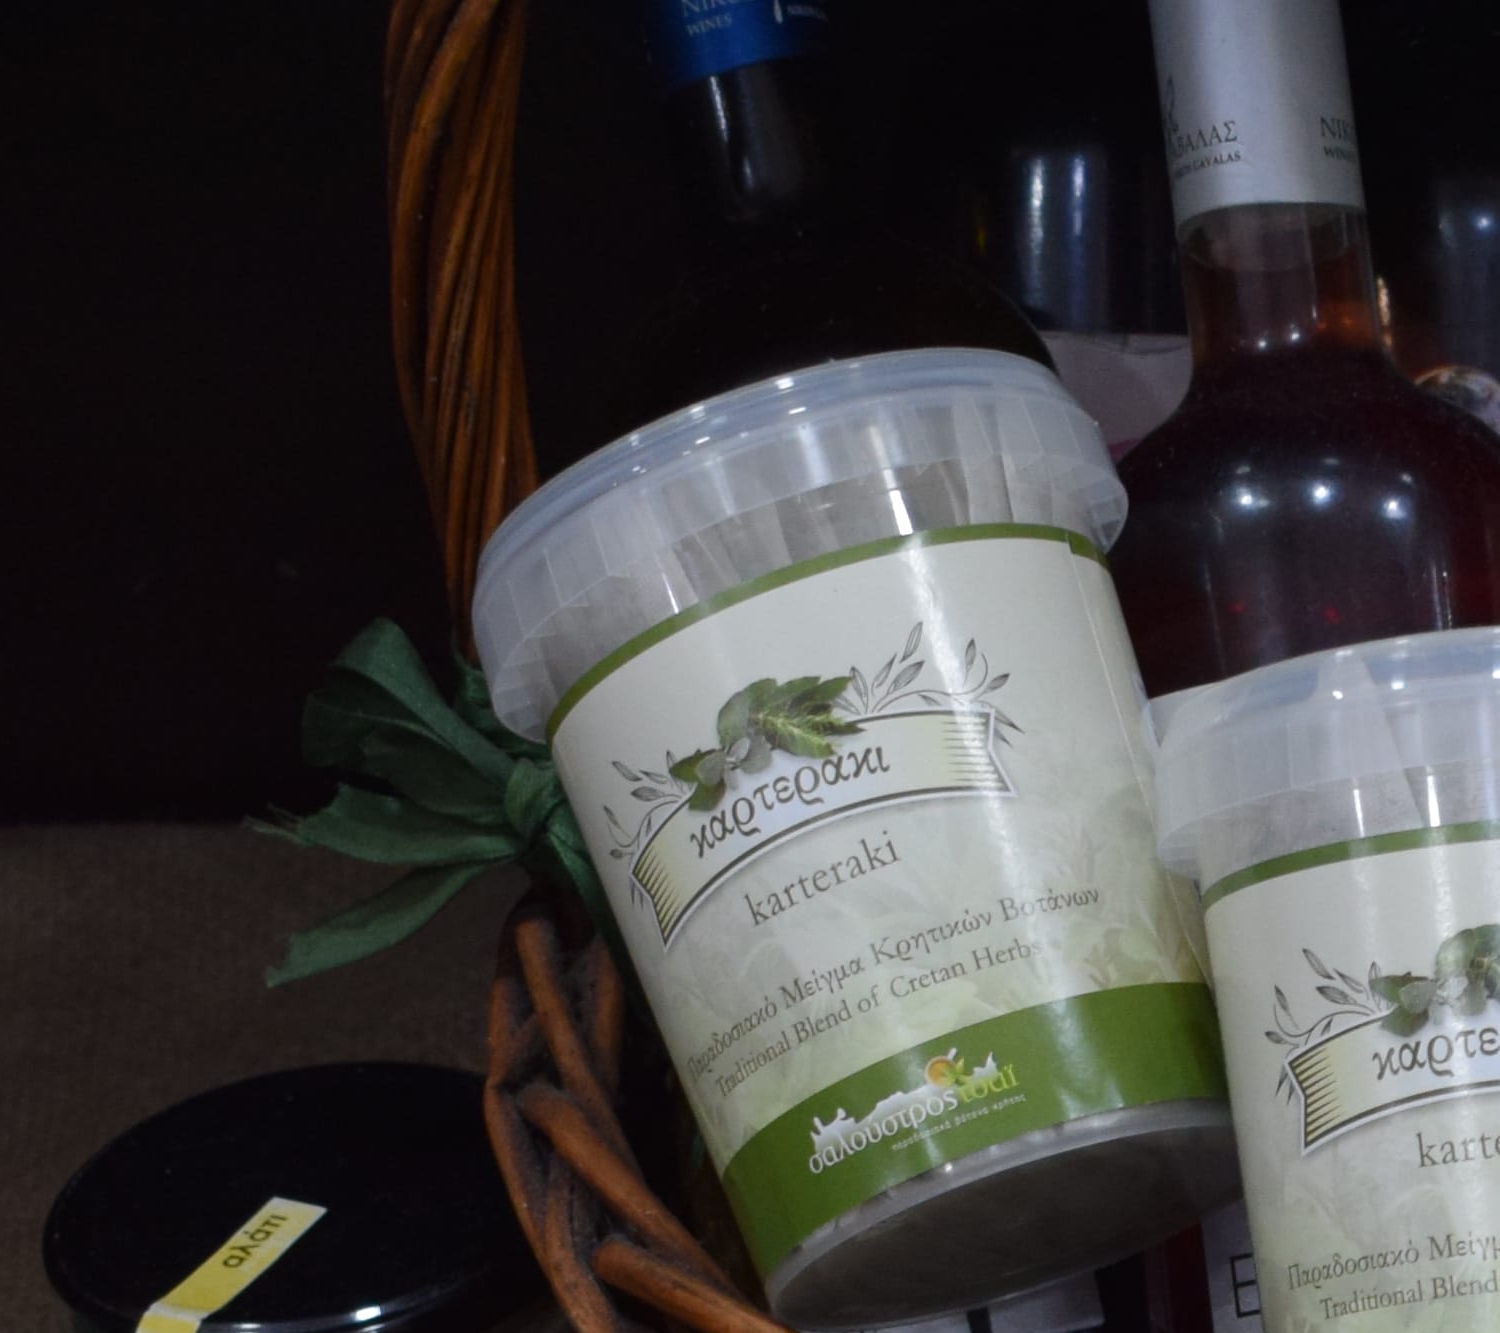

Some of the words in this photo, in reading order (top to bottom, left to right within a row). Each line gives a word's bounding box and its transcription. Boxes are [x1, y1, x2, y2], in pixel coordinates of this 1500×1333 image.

[744, 829, 901, 927] karteraki
[779, 955, 865, 1010] Μείγμα
[870, 909, 994, 966] Κρητικών
[998, 887, 1100, 922] Βοτάνων
[714, 1033, 794, 1098] Traditional
[793, 1000, 852, 1045] Blend
[857, 983, 883, 1014] of
[889, 960, 968, 999] Cretan
[971, 938, 1042, 971] Herbs
[222, 1213, 288, 1269] αλάτι
[1286, 1245, 1420, 1291] Παραδοσιακό
[1318, 1280, 1425, 1321] Traditional
[1431, 1268, 1500, 1300] Blend
